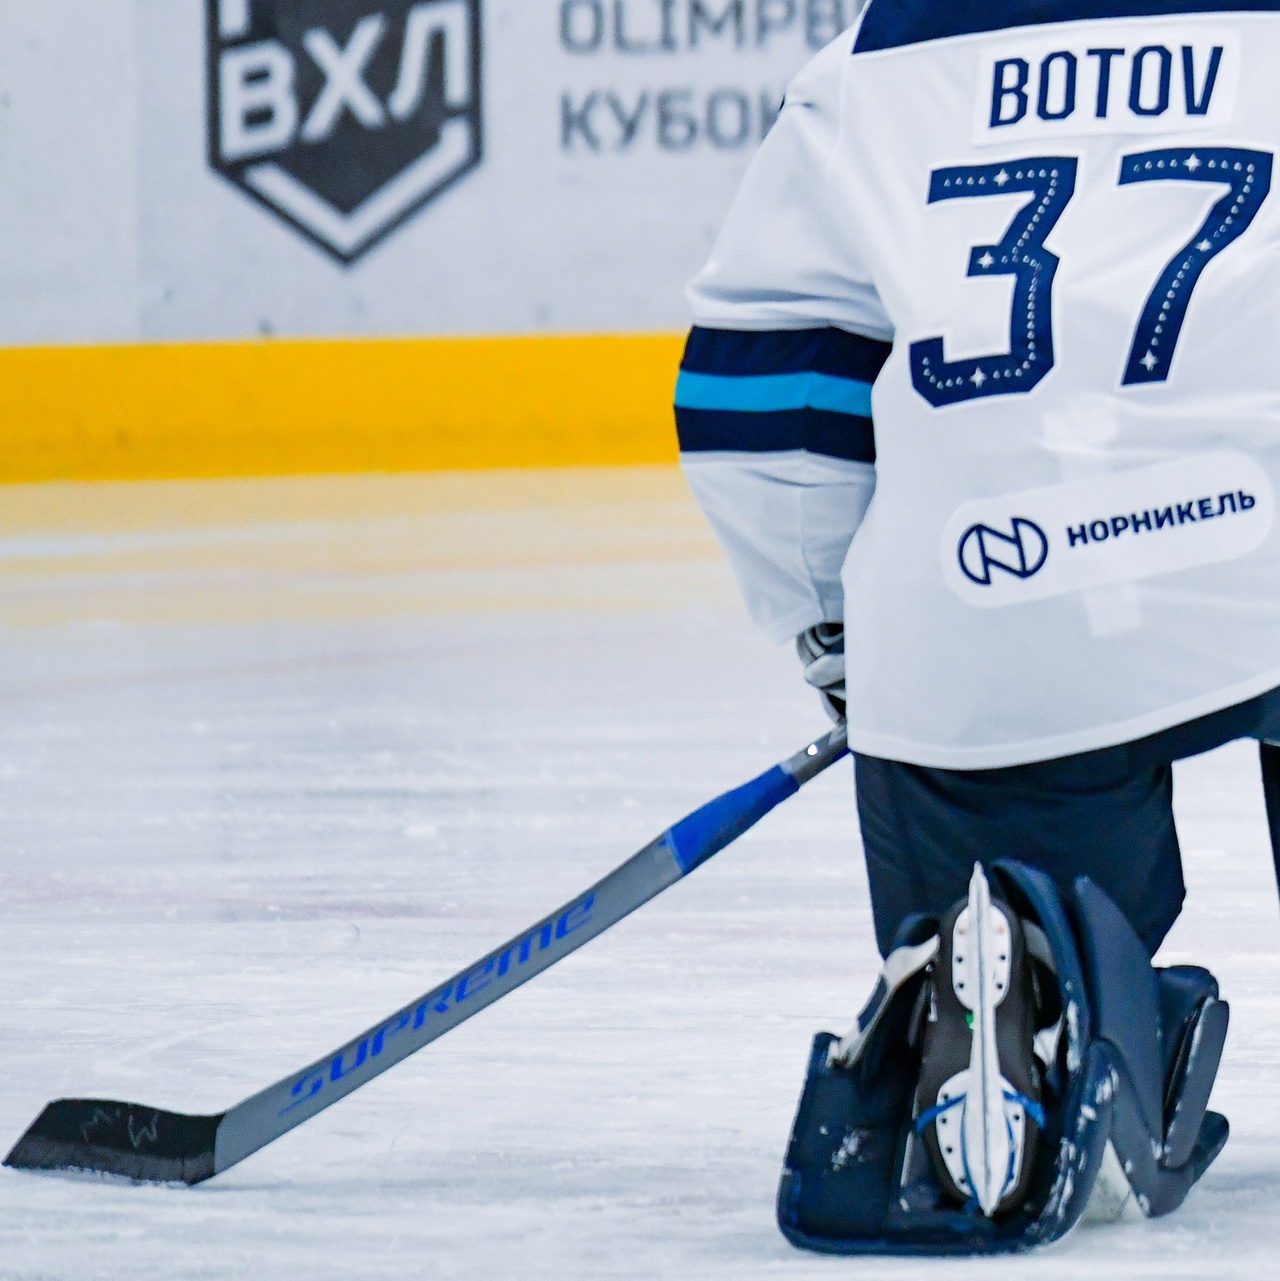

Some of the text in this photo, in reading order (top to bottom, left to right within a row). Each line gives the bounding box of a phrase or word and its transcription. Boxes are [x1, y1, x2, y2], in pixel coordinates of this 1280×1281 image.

[989, 45, 1224, 128] BOTOV
[909, 147, 1275, 409] 37
[1067, 490, 1256, 548] НОРНИКЕЛЬ
[279, 894, 596, 1116] SUPREME
